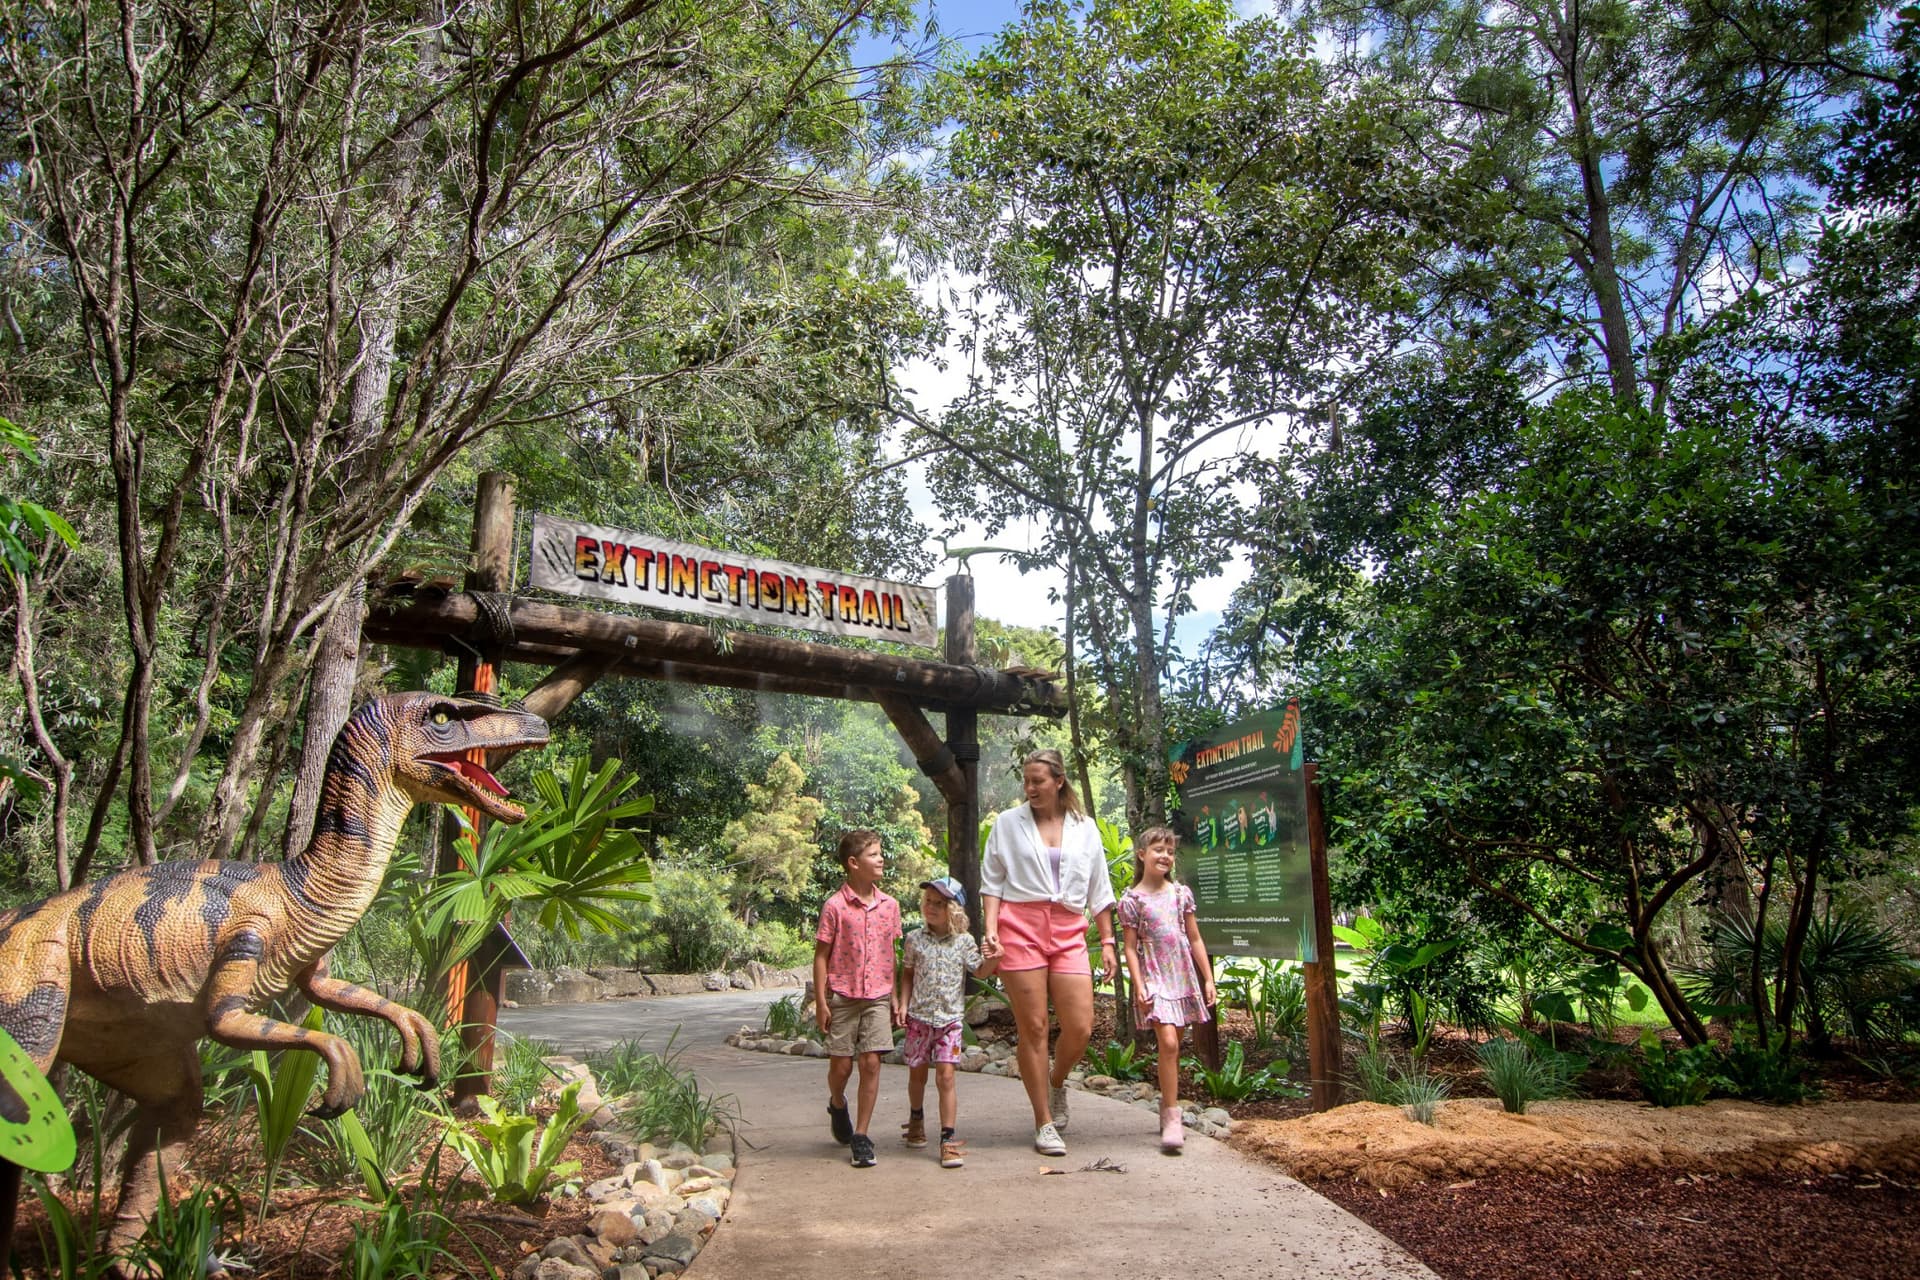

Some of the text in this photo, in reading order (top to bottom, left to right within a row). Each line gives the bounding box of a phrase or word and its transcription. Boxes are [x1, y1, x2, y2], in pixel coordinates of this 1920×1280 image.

[574, 535, 911, 632] EXTINCTION TRAIL
[1196, 730, 1265, 769] EXTINCTION TRAIL
